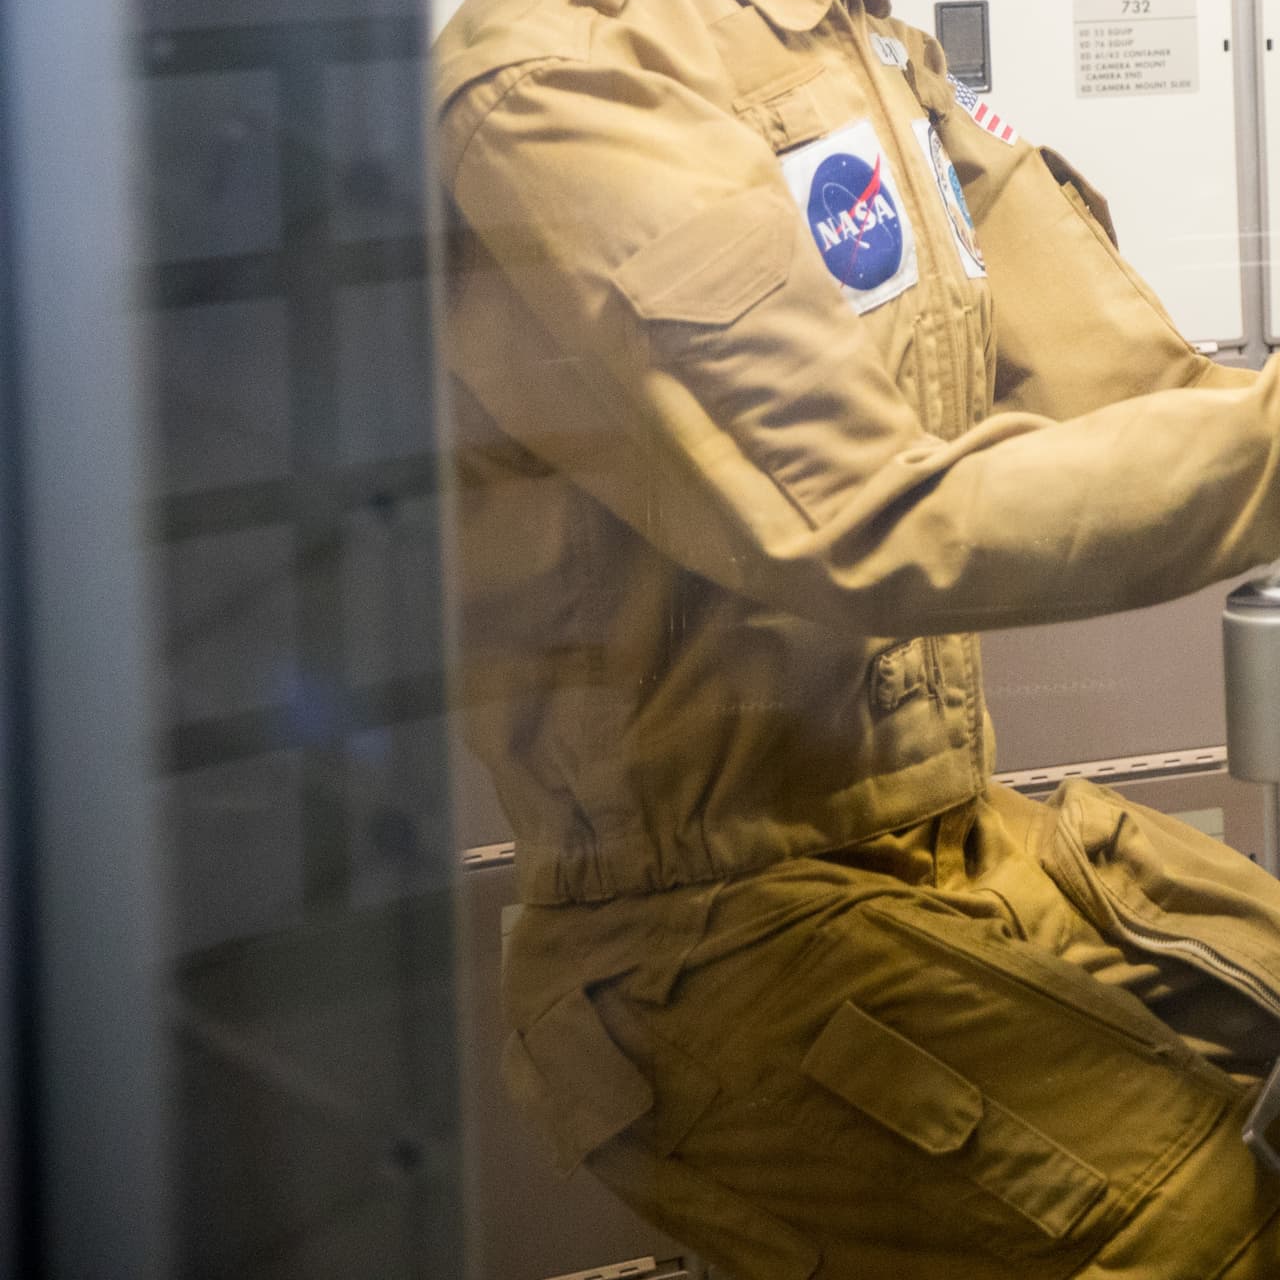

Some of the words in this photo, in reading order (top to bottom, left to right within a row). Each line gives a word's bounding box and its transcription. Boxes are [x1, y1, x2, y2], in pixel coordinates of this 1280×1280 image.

[1121, 0, 1152, 14] 732
[1095, 62, 1131, 71] CAMERA
[1085, 73, 1121, 81] CAMERA
[1095, 83, 1131, 92] CAMERA
[815, 193, 897, 252] NASA
